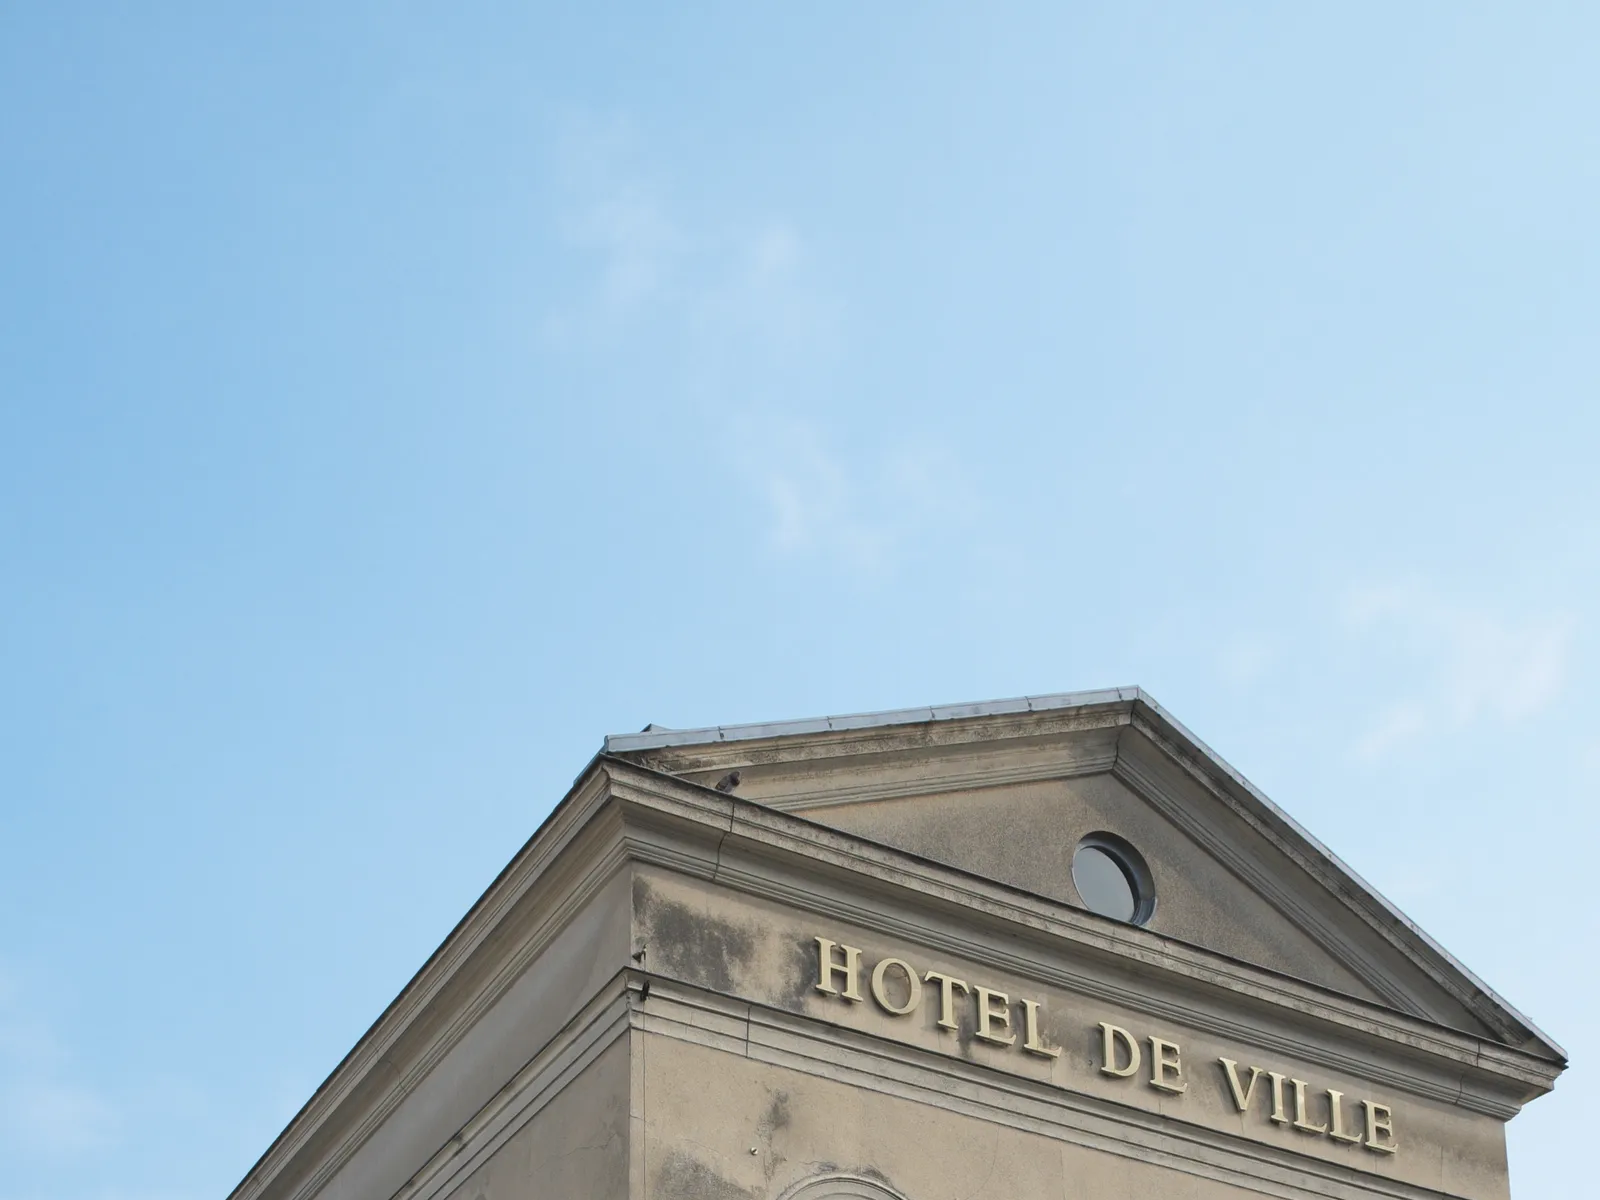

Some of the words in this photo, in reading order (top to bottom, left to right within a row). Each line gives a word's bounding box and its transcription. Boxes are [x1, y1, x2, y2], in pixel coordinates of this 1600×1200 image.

[814, 936, 1062, 1057] HOTEL
[1098, 1022, 1187, 1093] DE
[1218, 1057, 1398, 1153] VILLE
